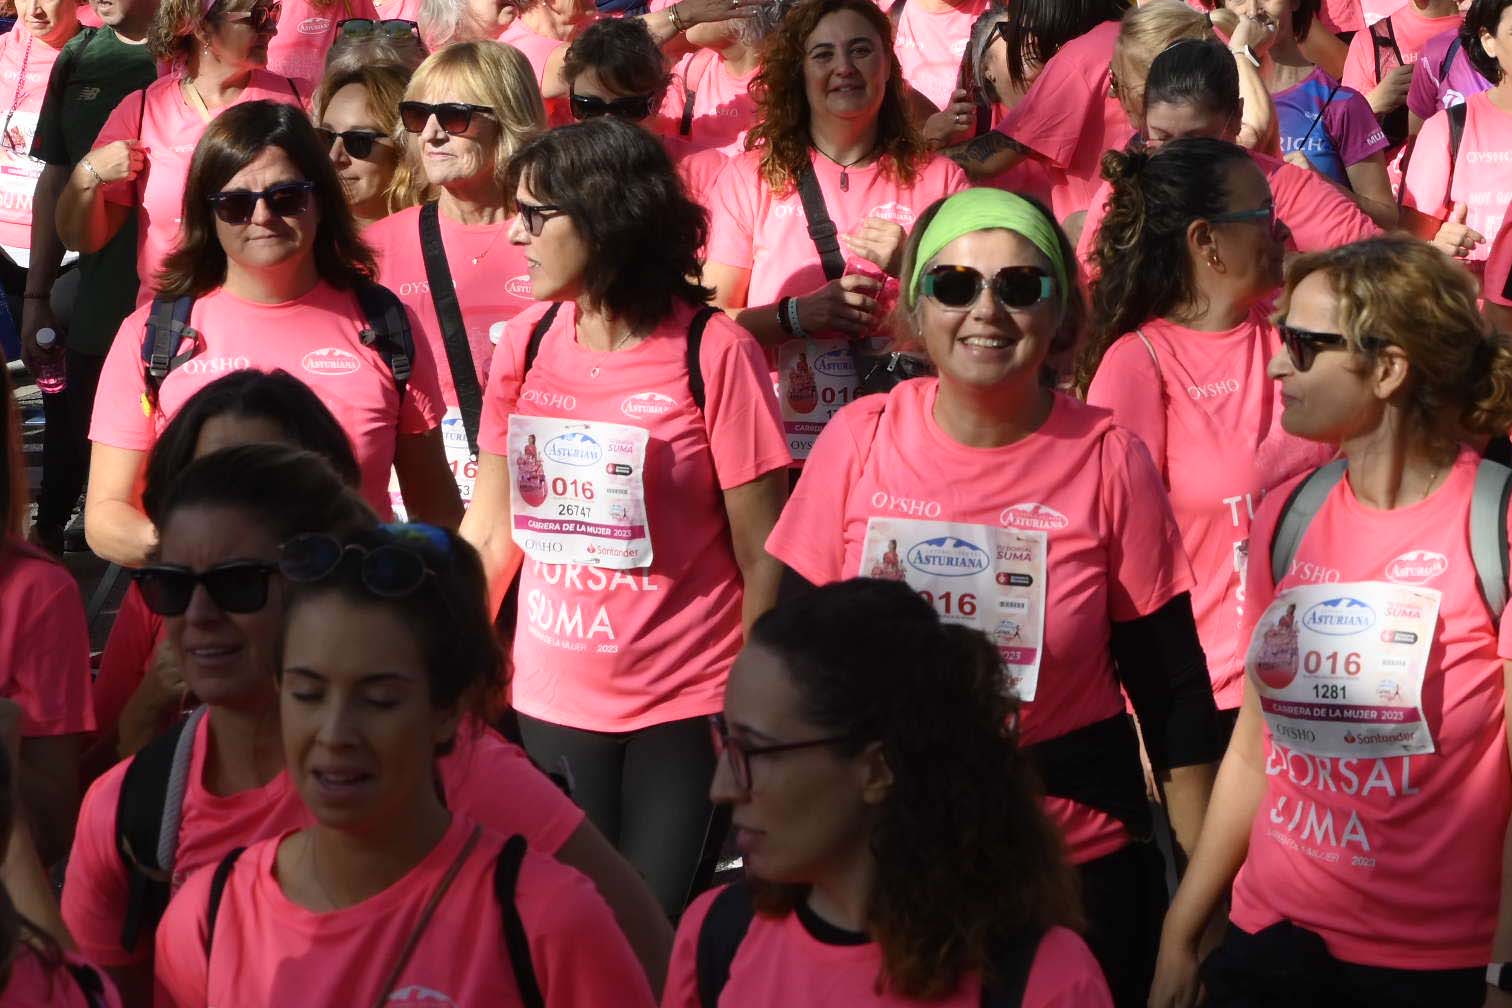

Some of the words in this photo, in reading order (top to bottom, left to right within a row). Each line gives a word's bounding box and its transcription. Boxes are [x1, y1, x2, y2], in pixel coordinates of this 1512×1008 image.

[183, 355, 251, 376] OYSHO
[1187, 378, 1240, 401] OYSHO
[522, 390, 577, 411] OYSHO
[607, 442, 635, 455] SUMA
[790, 440, 813, 450] OYS
[451, 461, 479, 479] 16
[551, 477, 595, 500] 016
[558, 503, 591, 519] 26747
[871, 491, 942, 518] OYSHO
[562, 522, 575, 532] DE
[587, 526, 612, 536] MUJER
[613, 528, 632, 538] 2023
[597, 545, 639, 558] Santander
[913, 549, 984, 569] ASTURIANA
[996, 551, 1032, 562] SUMA
[533, 563, 658, 592] ORSAL
[1291, 559, 1340, 584] YSHO
[527, 588, 616, 641] SUMA
[1307, 610, 1370, 626] ASTURIANA
[1385, 607, 1421, 619] SUMA
[1303, 650, 1361, 676] 016
[1312, 683, 1347, 699] 1281
[1273, 703, 1313, 715] CARRERA
[1314, 706, 1328, 717] DE
[1329, 707, 1342, 718] LA
[1343, 707, 1378, 720] MUJER
[1381, 710, 1404, 721] 2023
[1356, 732, 1416, 745] Santander
[1265, 742, 1421, 798] DORSAL
